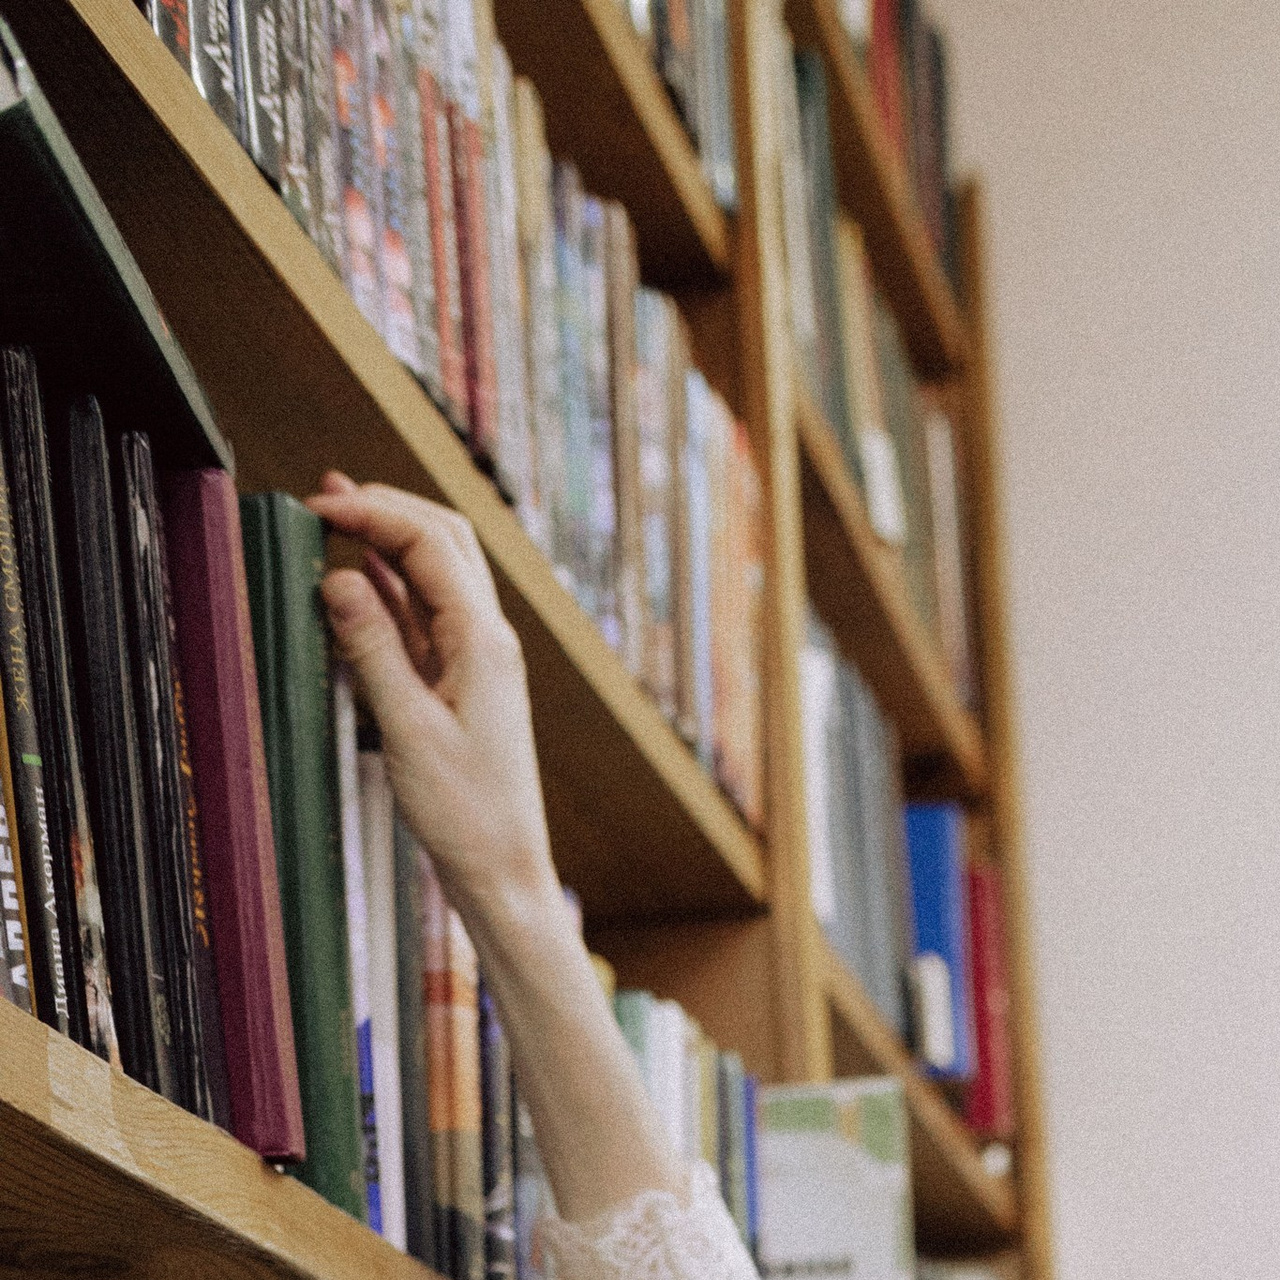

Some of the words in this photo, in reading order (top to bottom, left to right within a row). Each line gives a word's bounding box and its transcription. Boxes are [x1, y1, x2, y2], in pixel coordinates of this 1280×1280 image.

[8, 622, 31, 715] ЖЕНА
[34, 785, 59, 918] Акерман
[50, 926, 70, 1019] Диана
